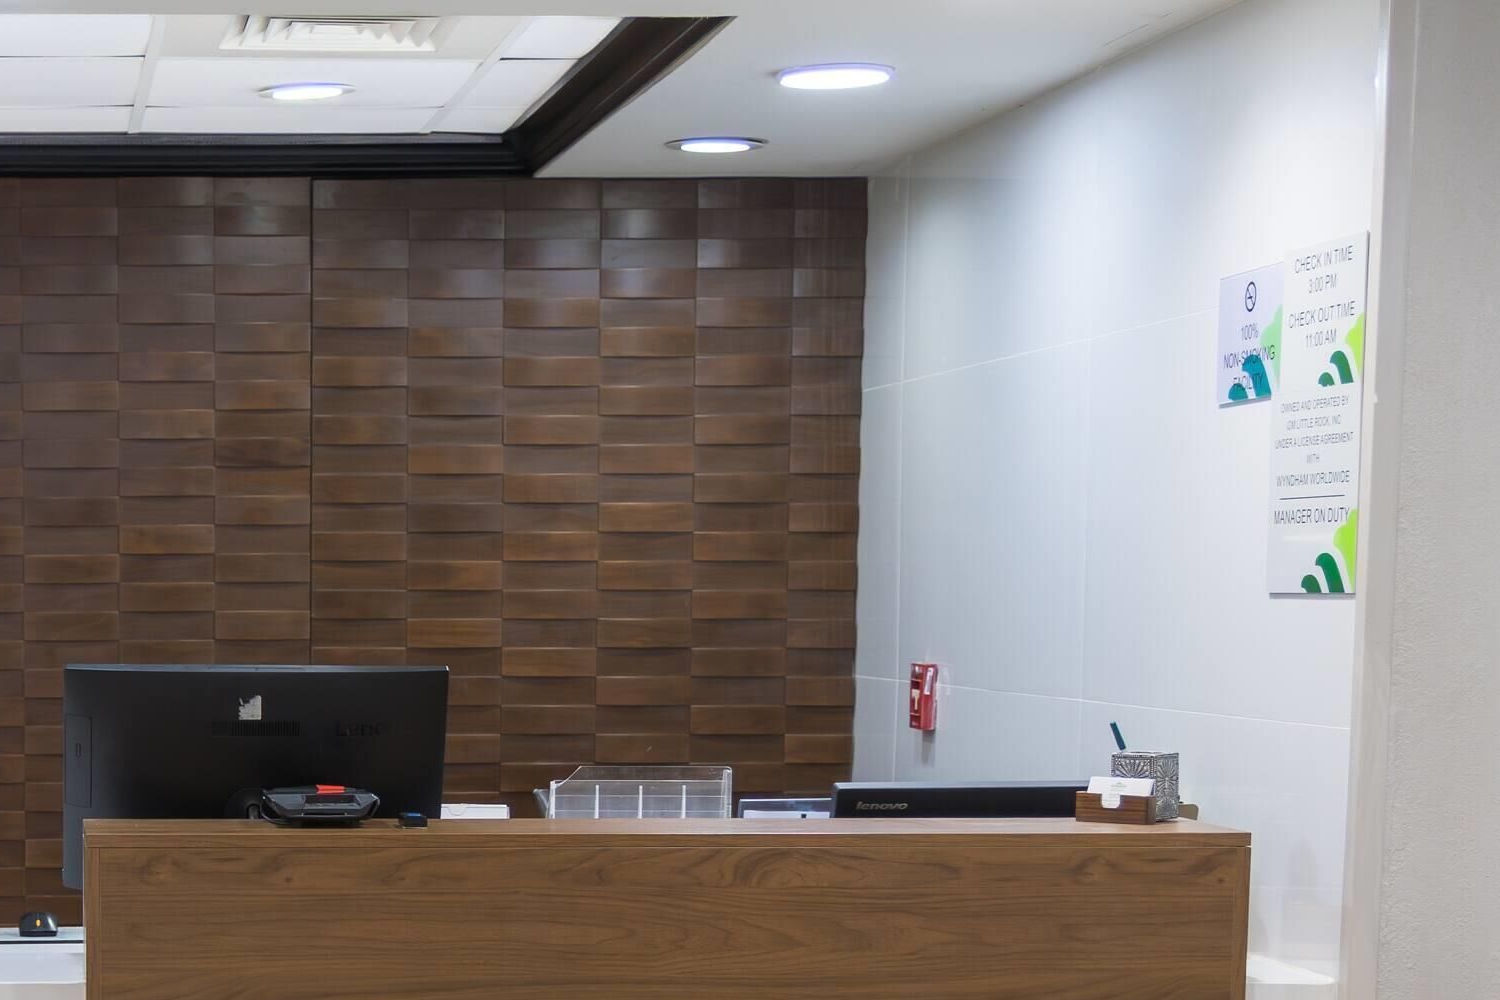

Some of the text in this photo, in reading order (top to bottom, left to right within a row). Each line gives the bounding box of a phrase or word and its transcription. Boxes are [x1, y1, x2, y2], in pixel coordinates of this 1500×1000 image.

[1294, 245, 1353, 274] CHECK IN TIME
[1309, 273, 1337, 294] 3:00 PM
[1289, 300, 1356, 329] CHECK OUT TIME
[1241, 322, 1259, 341] 100%
[1306, 328, 1337, 349] 11:00 AM
[1313, 396, 1340, 410] OPERATED
[1276, 470, 1350, 487] WYNDHAM WORLDWIDE
[1274, 507, 1349, 525] MANAGER ON DUTY
[856, 801, 908, 810] lenovo
